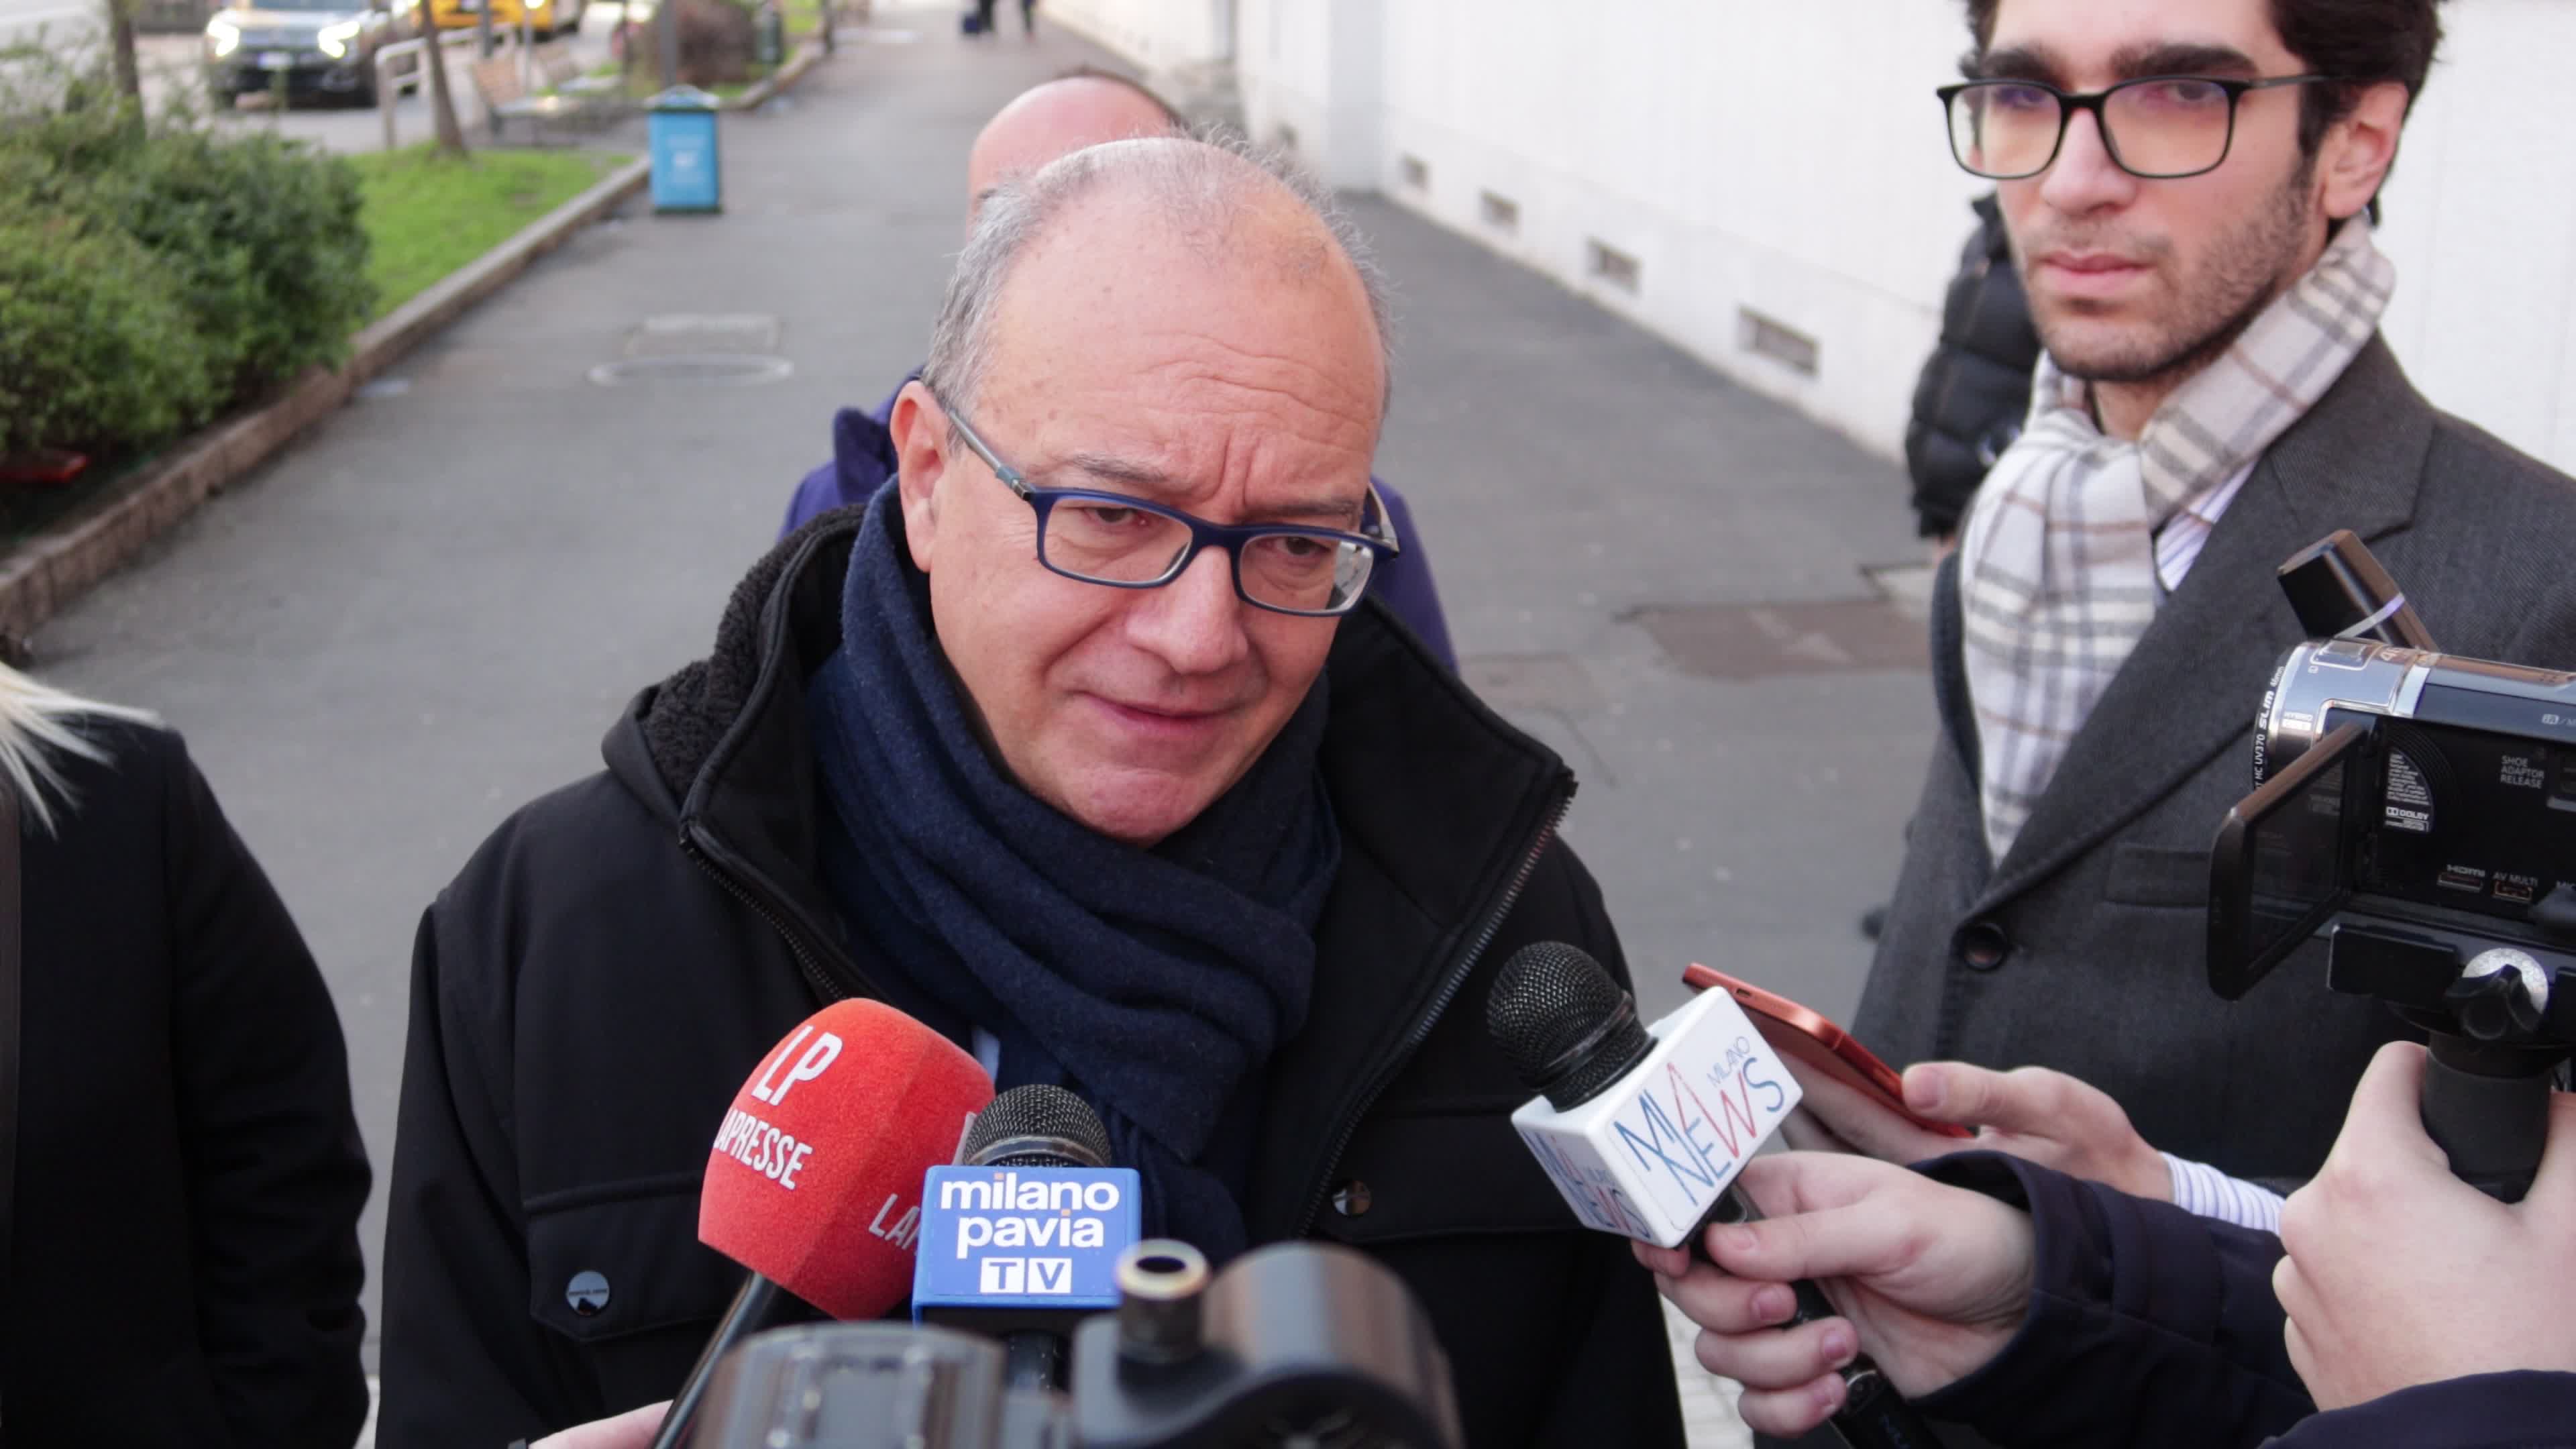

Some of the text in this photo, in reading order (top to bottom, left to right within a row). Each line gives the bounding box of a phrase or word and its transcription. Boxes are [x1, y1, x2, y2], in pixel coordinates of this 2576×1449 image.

[2254, 734, 2266, 765] UV370
[751, 1025, 843, 1106] LP
[1665, 1057, 1785, 1207] NEWS
[941, 1173, 1120, 1211] milano
[957, 1209, 1104, 1259] pavia
[989, 1262, 1066, 1293] TV
